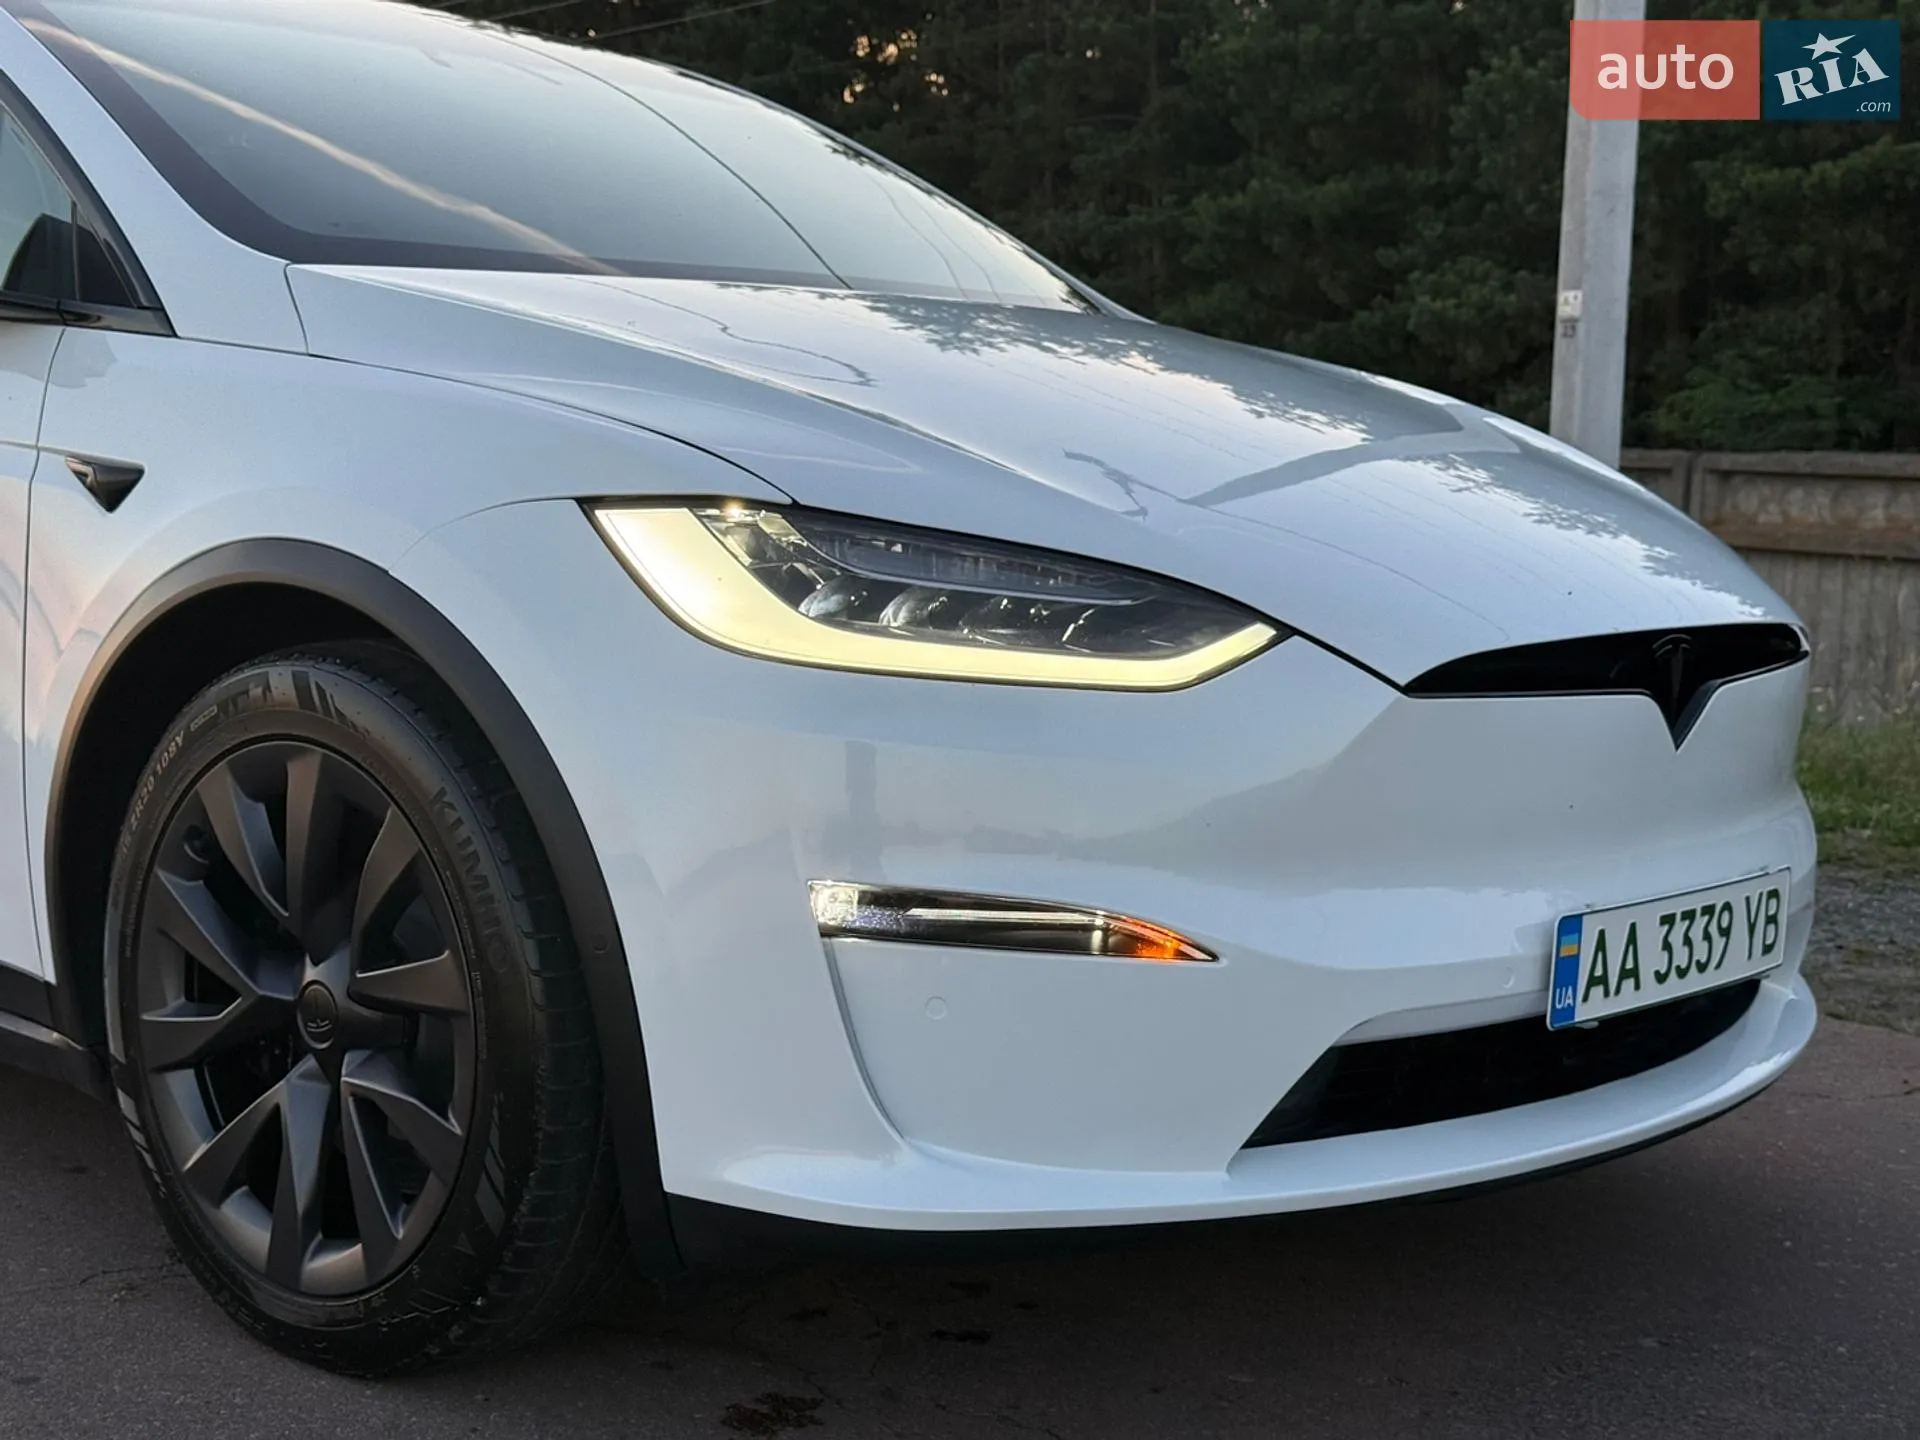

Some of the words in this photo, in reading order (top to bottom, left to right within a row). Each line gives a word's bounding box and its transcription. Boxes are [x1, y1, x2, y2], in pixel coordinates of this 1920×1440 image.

[1581, 921, 1642, 1004] AA
[1653, 900, 1735, 986] 3339
[1744, 887, 1782, 961] YB
[1554, 984, 1575, 1010] UA
